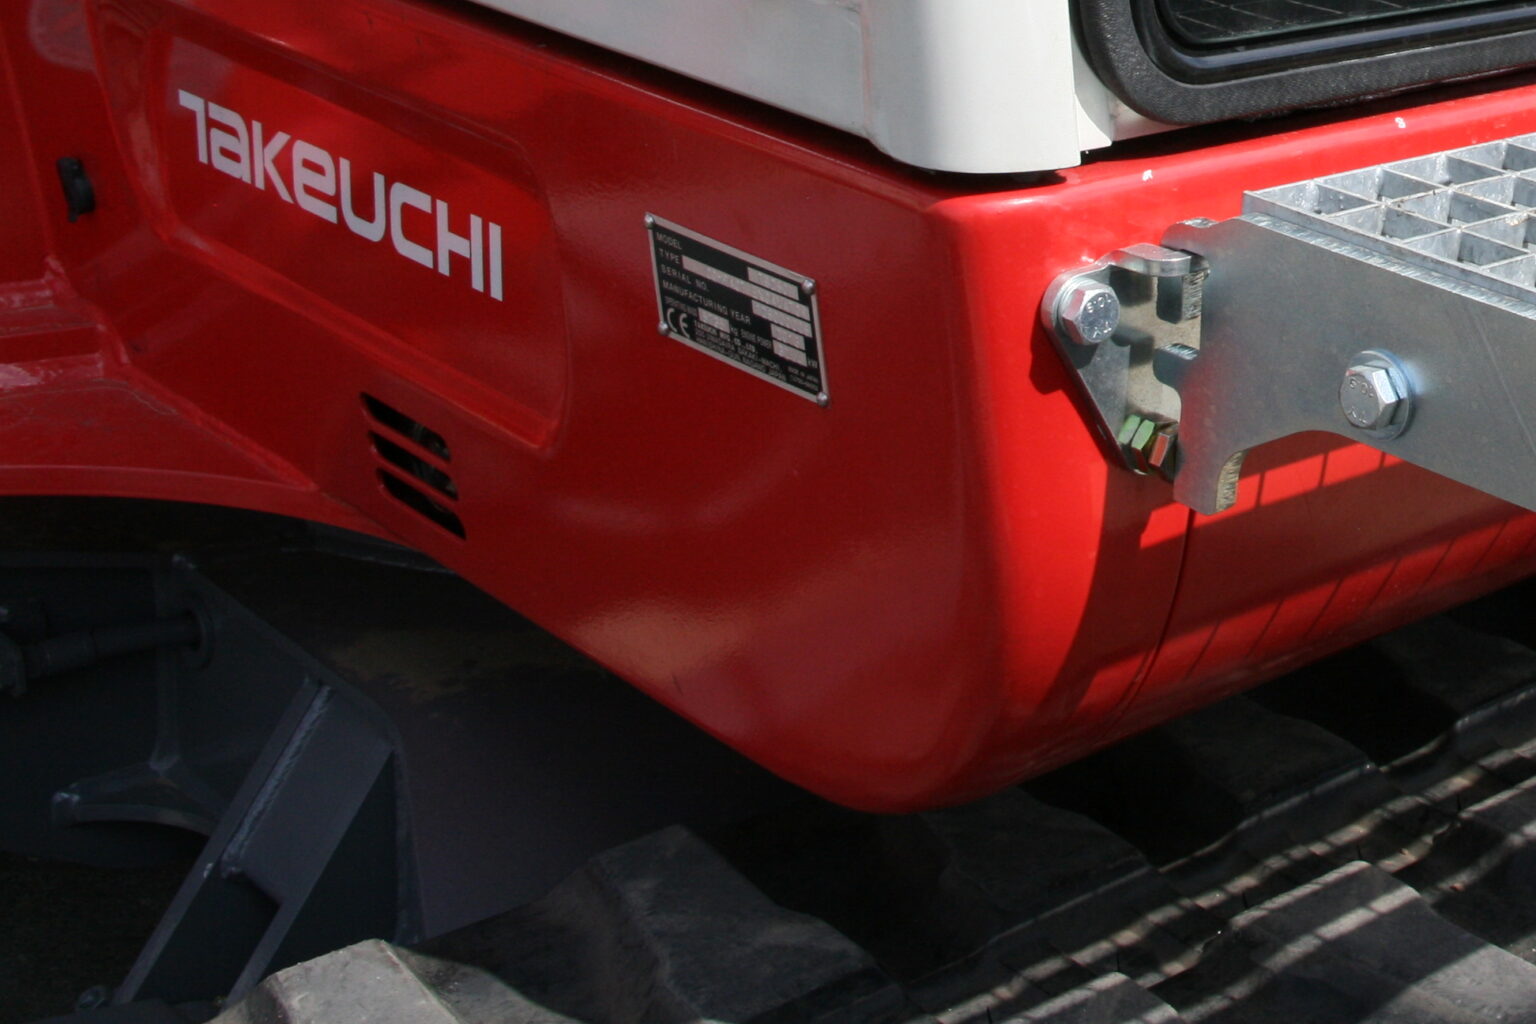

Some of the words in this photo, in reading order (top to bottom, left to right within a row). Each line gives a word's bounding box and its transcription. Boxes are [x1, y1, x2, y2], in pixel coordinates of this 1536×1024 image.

[656, 231, 682, 250] MODEL
[659, 248, 680, 264] TYPE
[667, 308, 690, 339] CE
[730, 309, 751, 325] YEAR
